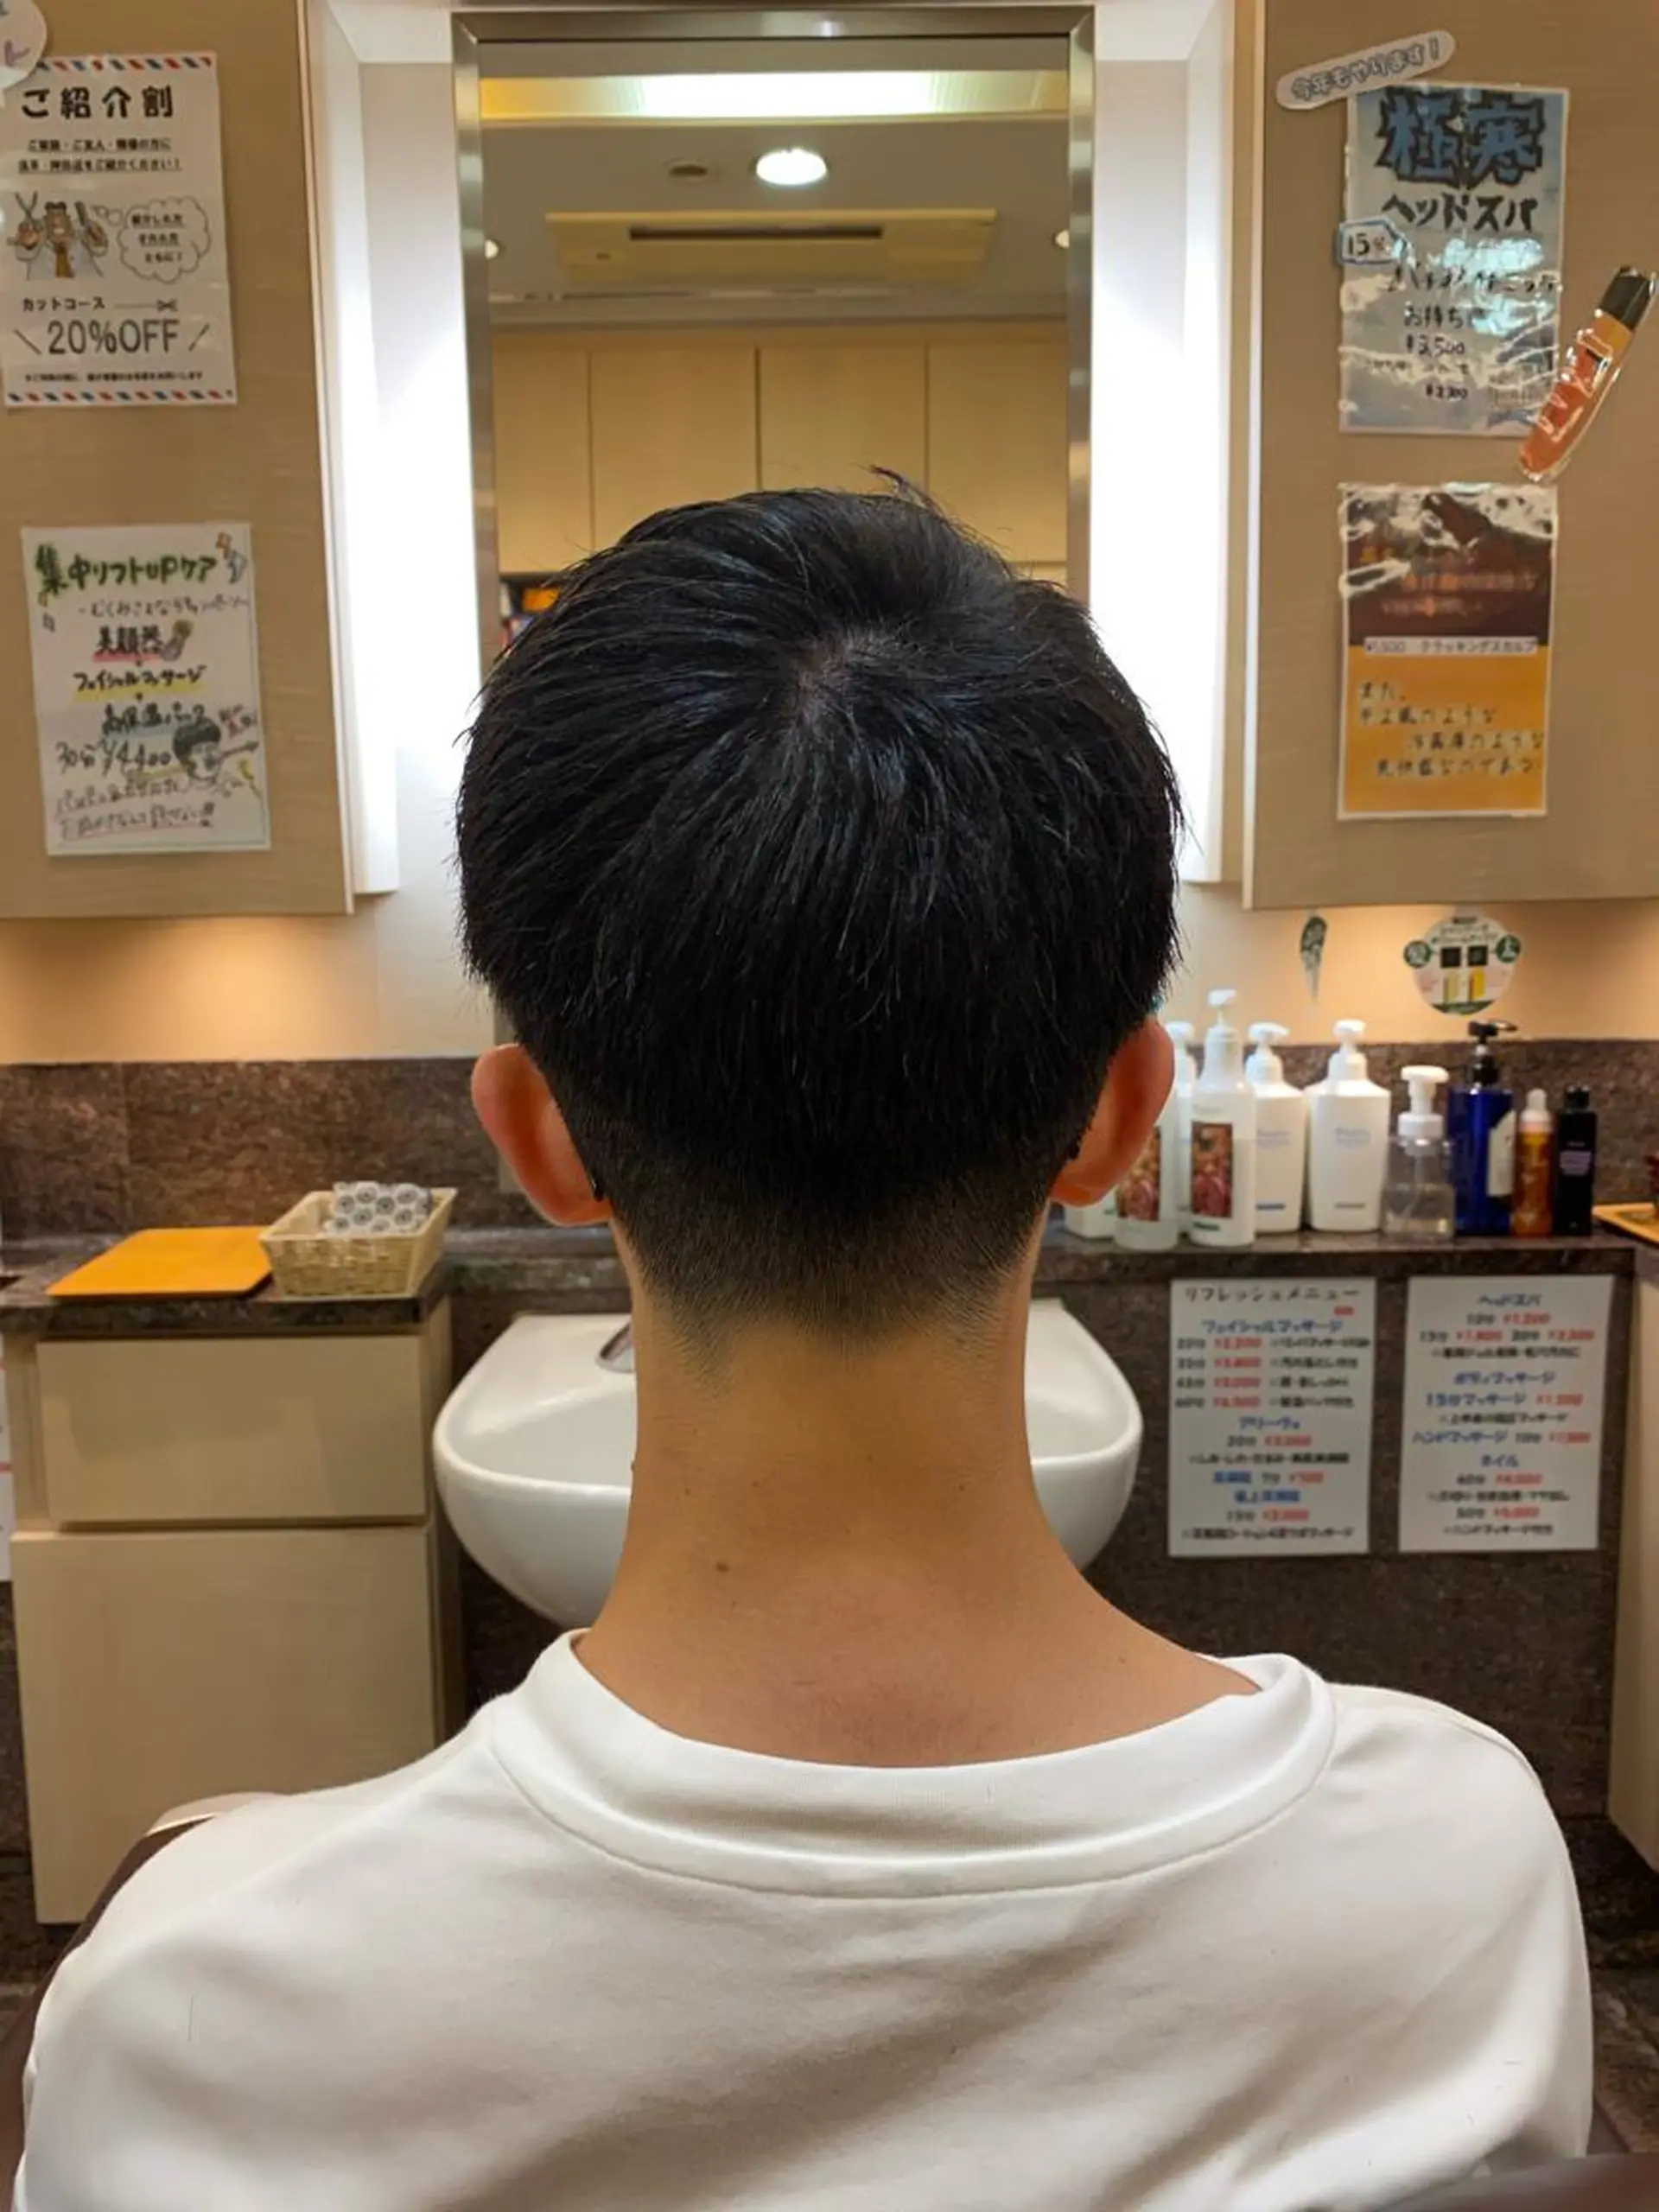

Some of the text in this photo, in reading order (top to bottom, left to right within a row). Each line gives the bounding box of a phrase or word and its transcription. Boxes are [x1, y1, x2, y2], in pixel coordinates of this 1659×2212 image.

[22, 85, 174, 118] ご紹介割
[1382, 192, 1538, 232] ヘッドスパ
[22, 297, 105, 312] カットコース
[47, 318, 181, 355] 20%OFF
[1185, 1287, 1360, 1302] リフレッシュメニュー
